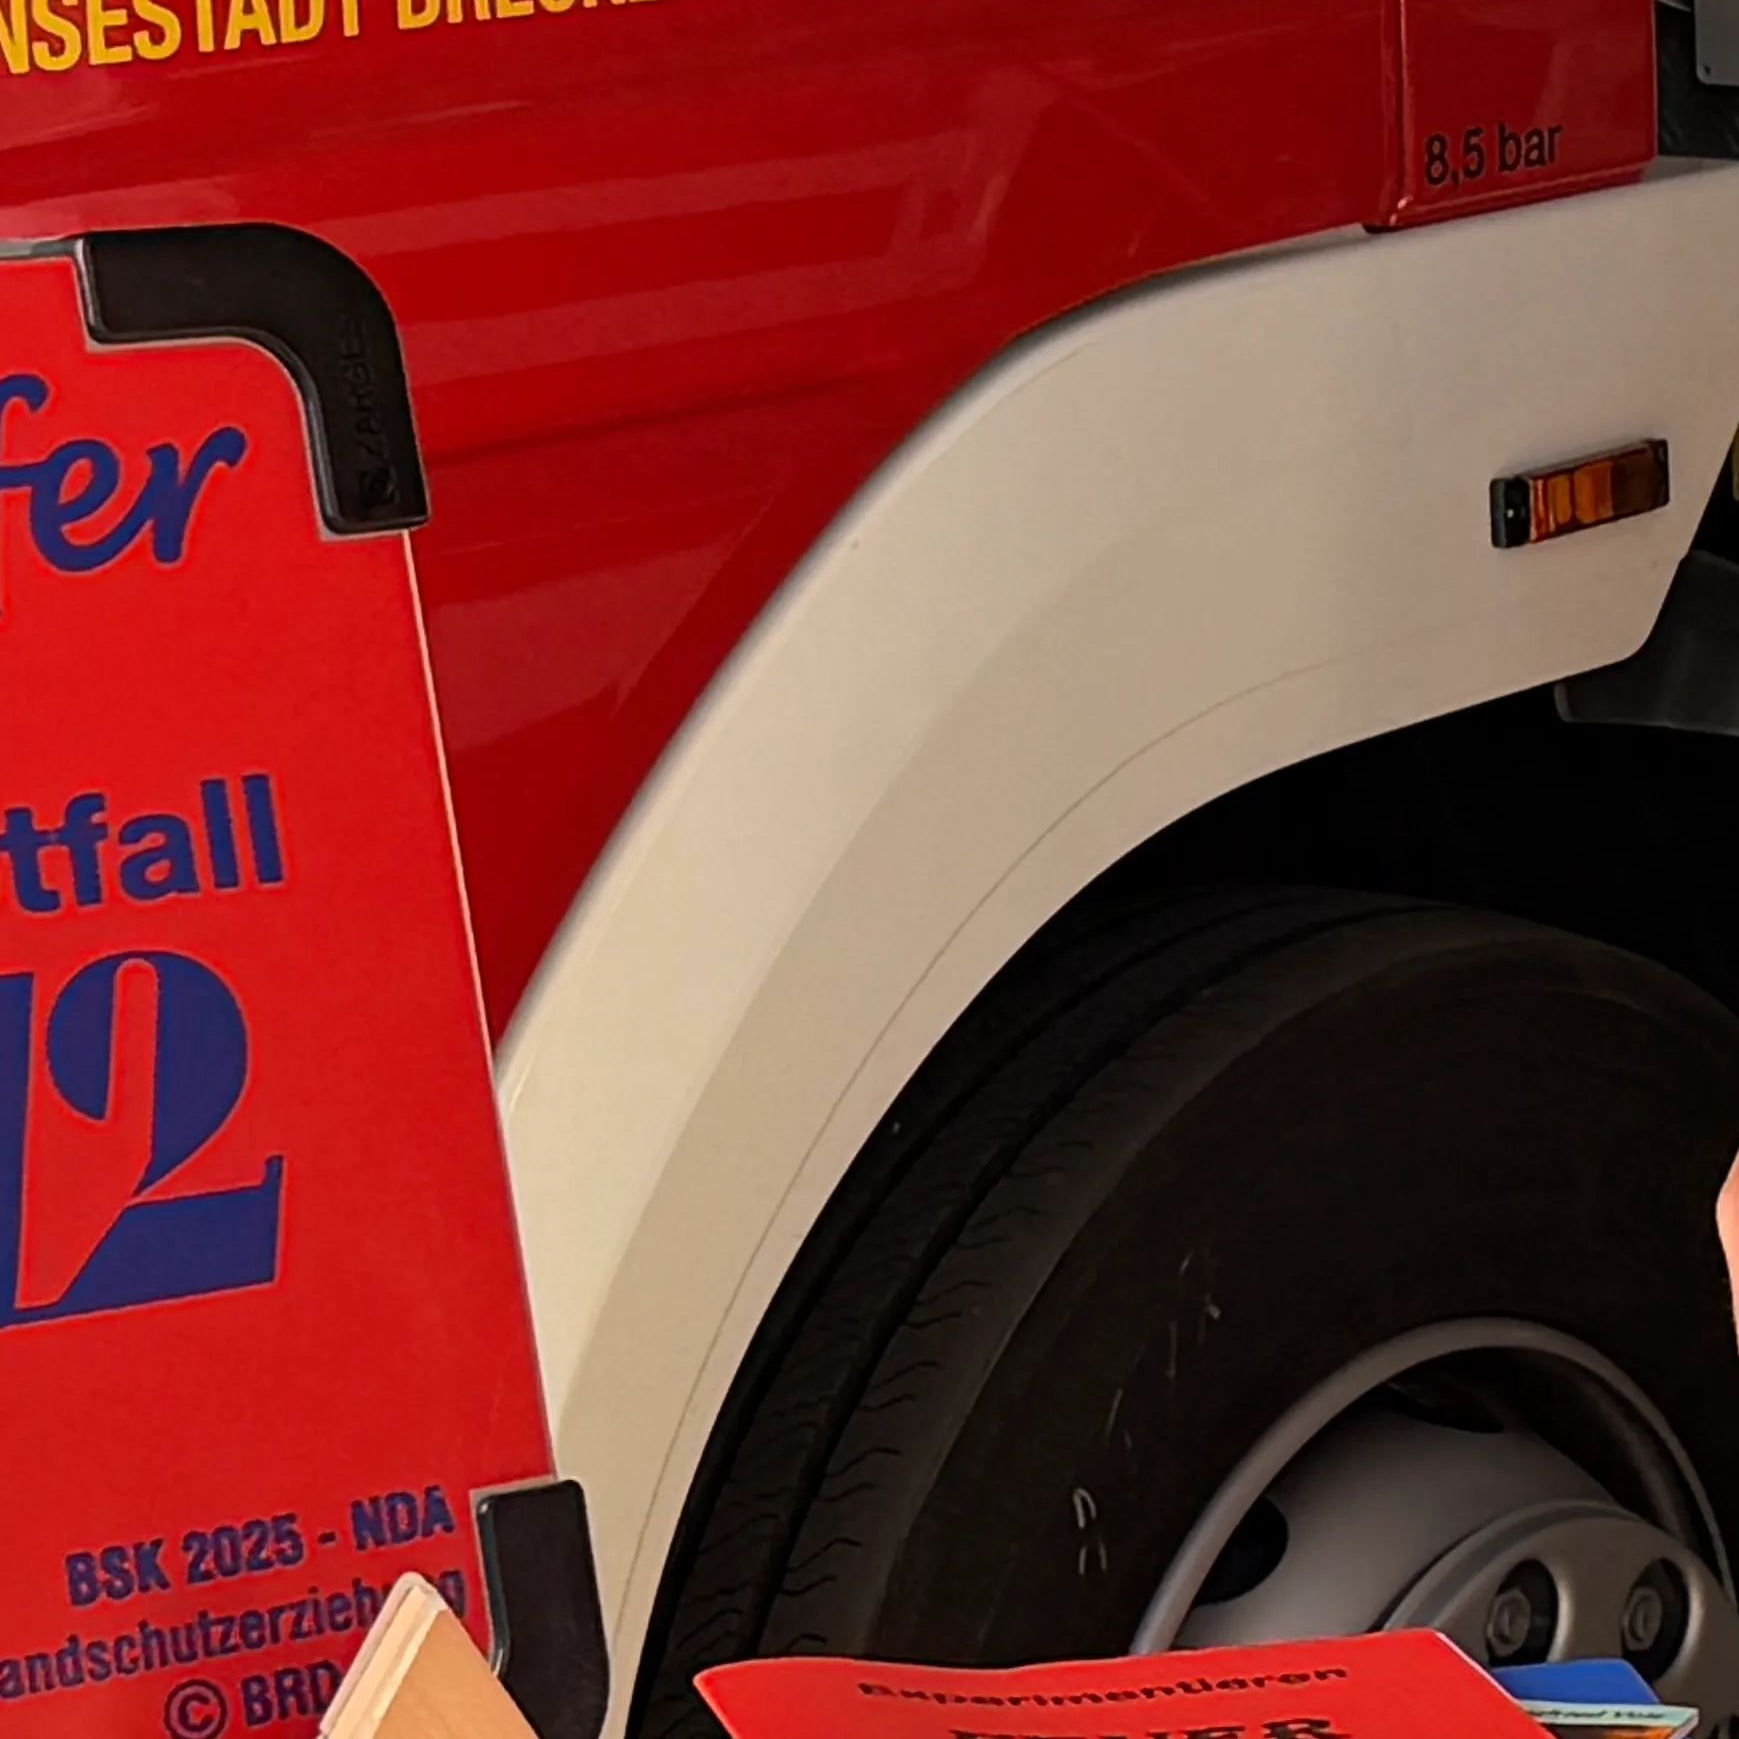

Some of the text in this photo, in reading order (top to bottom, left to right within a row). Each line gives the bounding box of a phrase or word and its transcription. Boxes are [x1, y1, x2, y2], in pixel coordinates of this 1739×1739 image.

[1424, 121, 1563, 189] 8,5 bar
[0, 772, 284, 913] tfall
[64, 1538, 171, 1607] BSK
[182, 1512, 305, 1584] 2025
[350, 1484, 455, 1551] NDA
